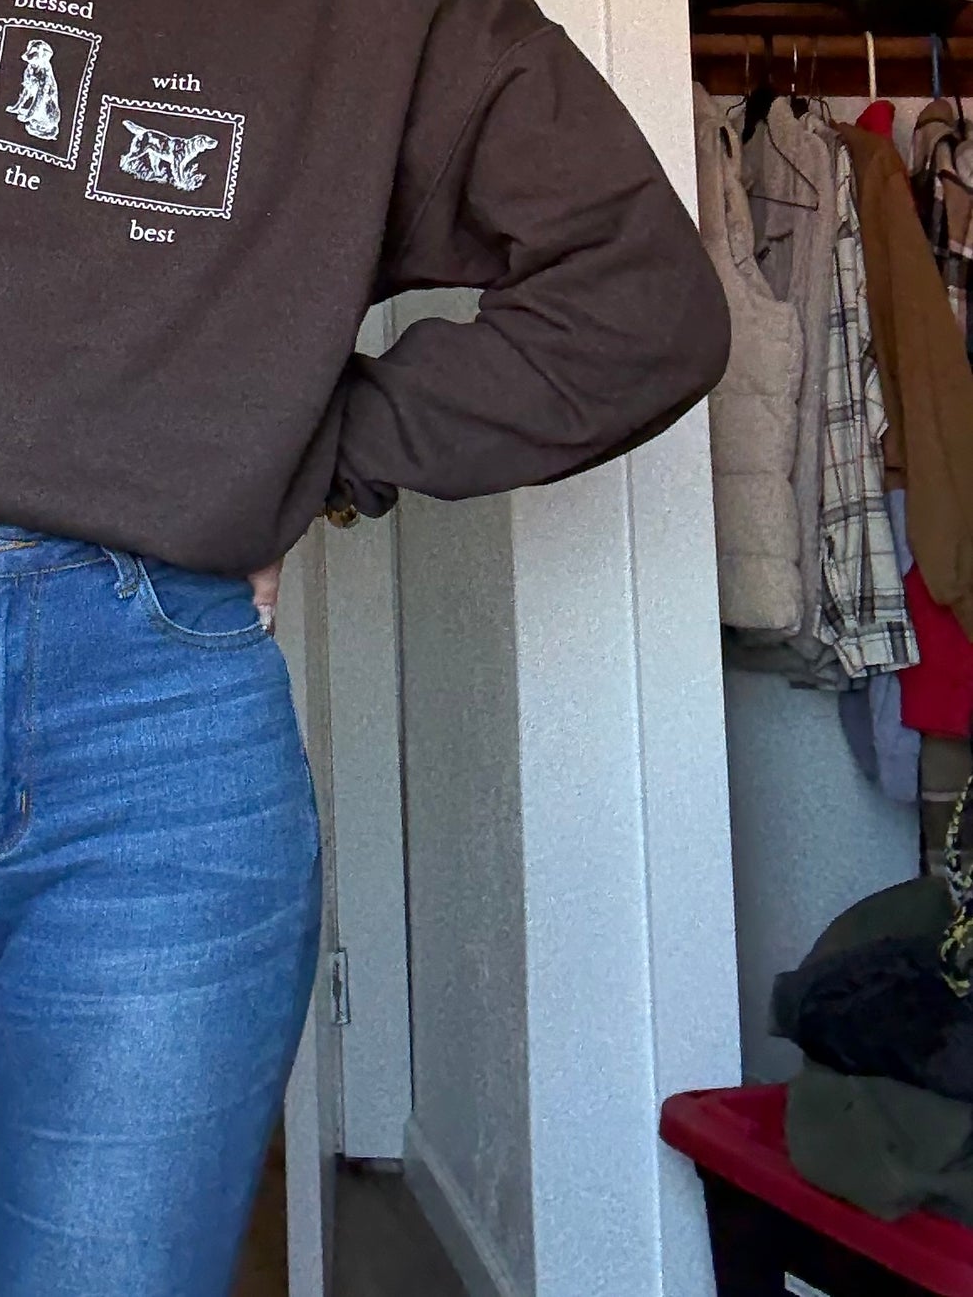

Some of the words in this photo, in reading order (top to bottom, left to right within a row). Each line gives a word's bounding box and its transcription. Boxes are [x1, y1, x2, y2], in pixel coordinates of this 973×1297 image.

[152, 73, 201, 92] with
[4, 165, 41, 190] the
[129, 219, 176, 243] best
